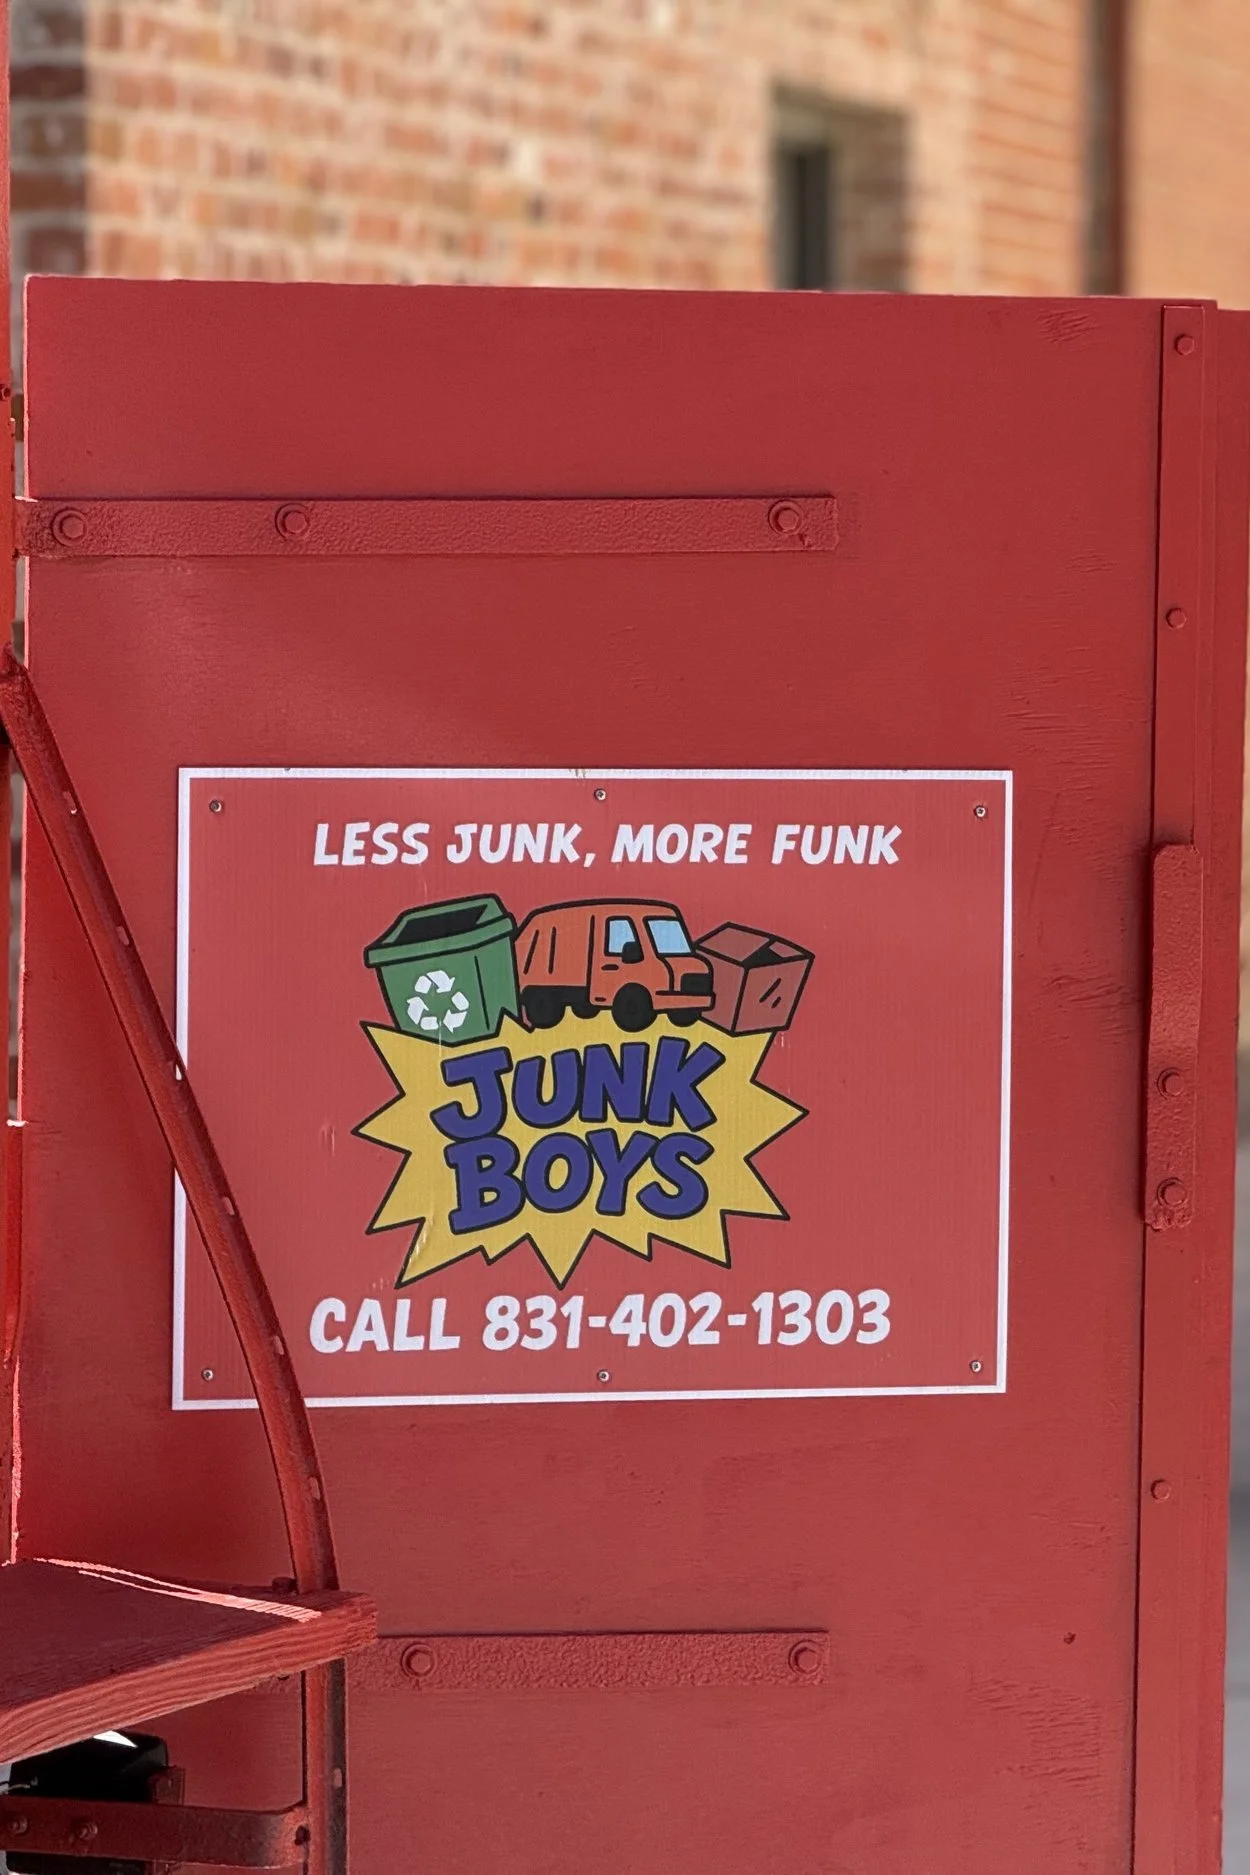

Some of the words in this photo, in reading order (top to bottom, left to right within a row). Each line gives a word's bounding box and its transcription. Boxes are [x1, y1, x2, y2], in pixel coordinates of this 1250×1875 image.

[313, 821, 429, 867] LESS
[446, 823, 596, 869] JUNK,
[611, 823, 753, 865] MORE
[772, 824, 901, 865] FUNK
[430, 1036, 726, 1141] JUNK
[444, 1129, 716, 1235] BOYS
[308, 1297, 461, 1354] CALL
[482, 1289, 892, 1351] 831-402-1303
